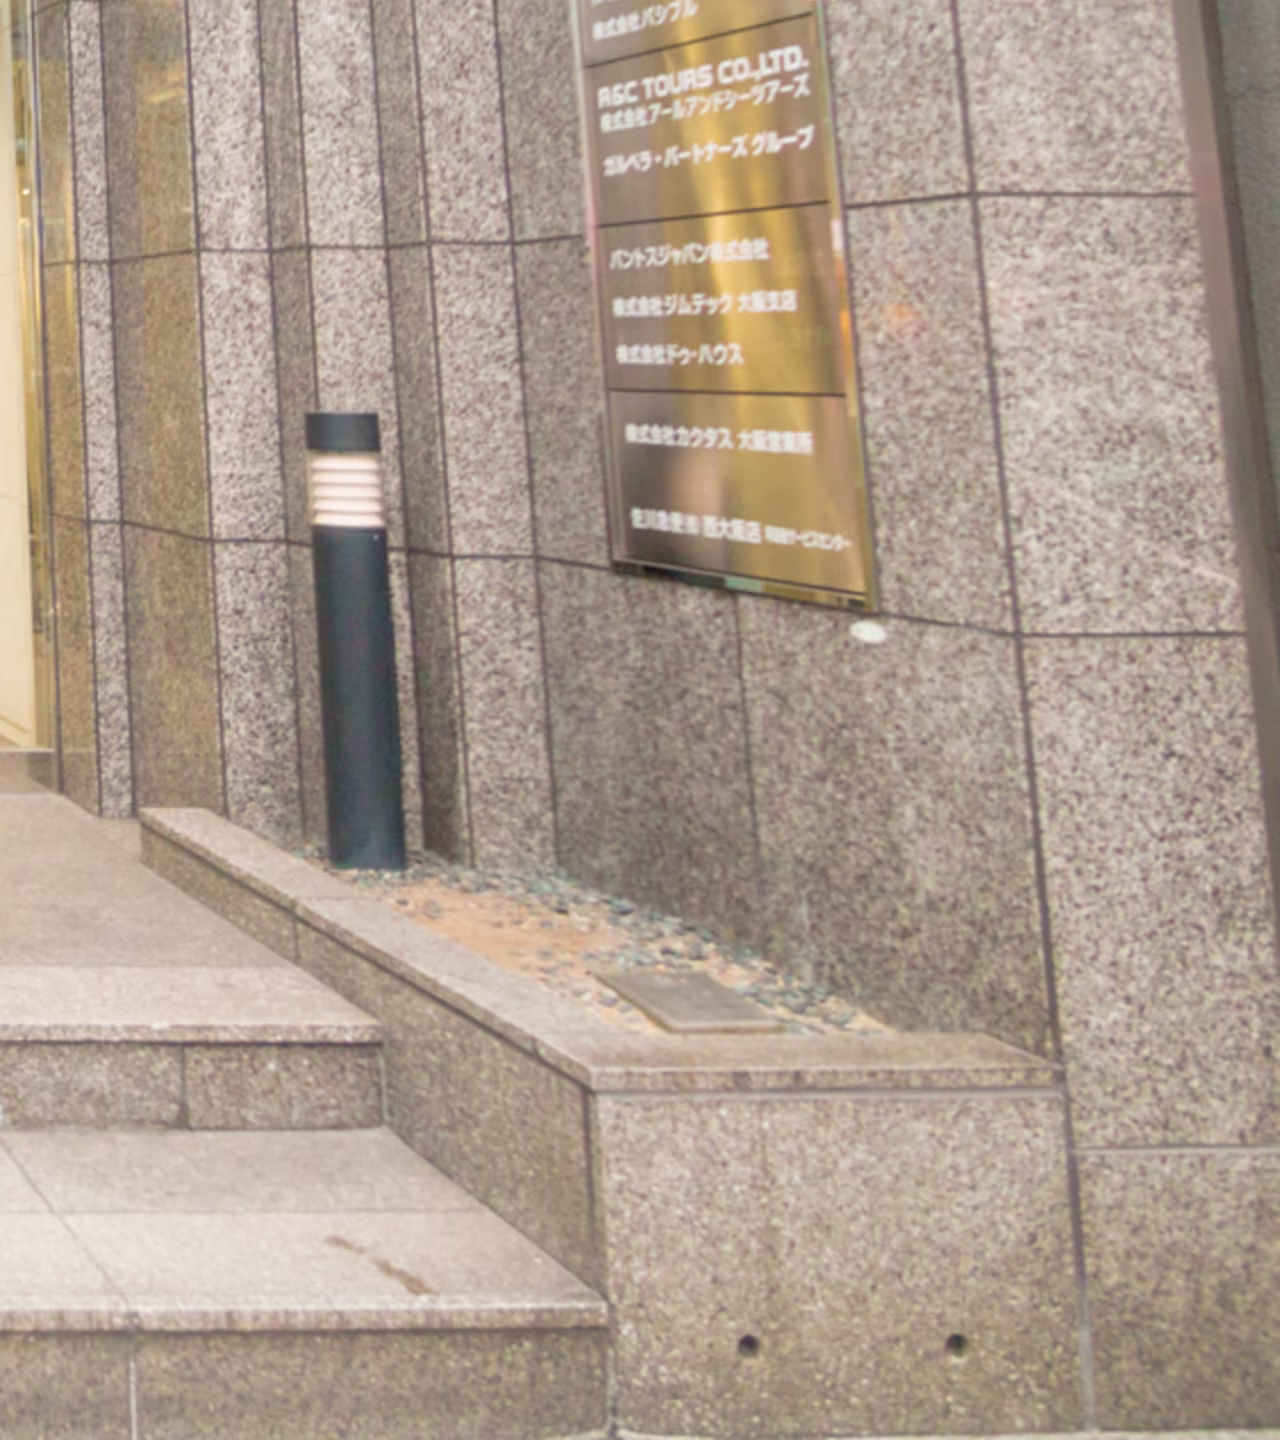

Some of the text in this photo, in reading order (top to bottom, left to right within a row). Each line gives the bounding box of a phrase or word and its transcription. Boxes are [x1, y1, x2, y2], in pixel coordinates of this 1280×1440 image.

[598, 82, 636, 110] R&C
[643, 64, 712, 100] TOURS
[600, 75, 810, 135] 株式会社アールアンドシーツアーズ
[609, 236, 768, 272] パントスジャパン株式会社
[612, 293, 732, 320] 株式会社ジムテック
[625, 425, 732, 449] 株式会社カクタス
